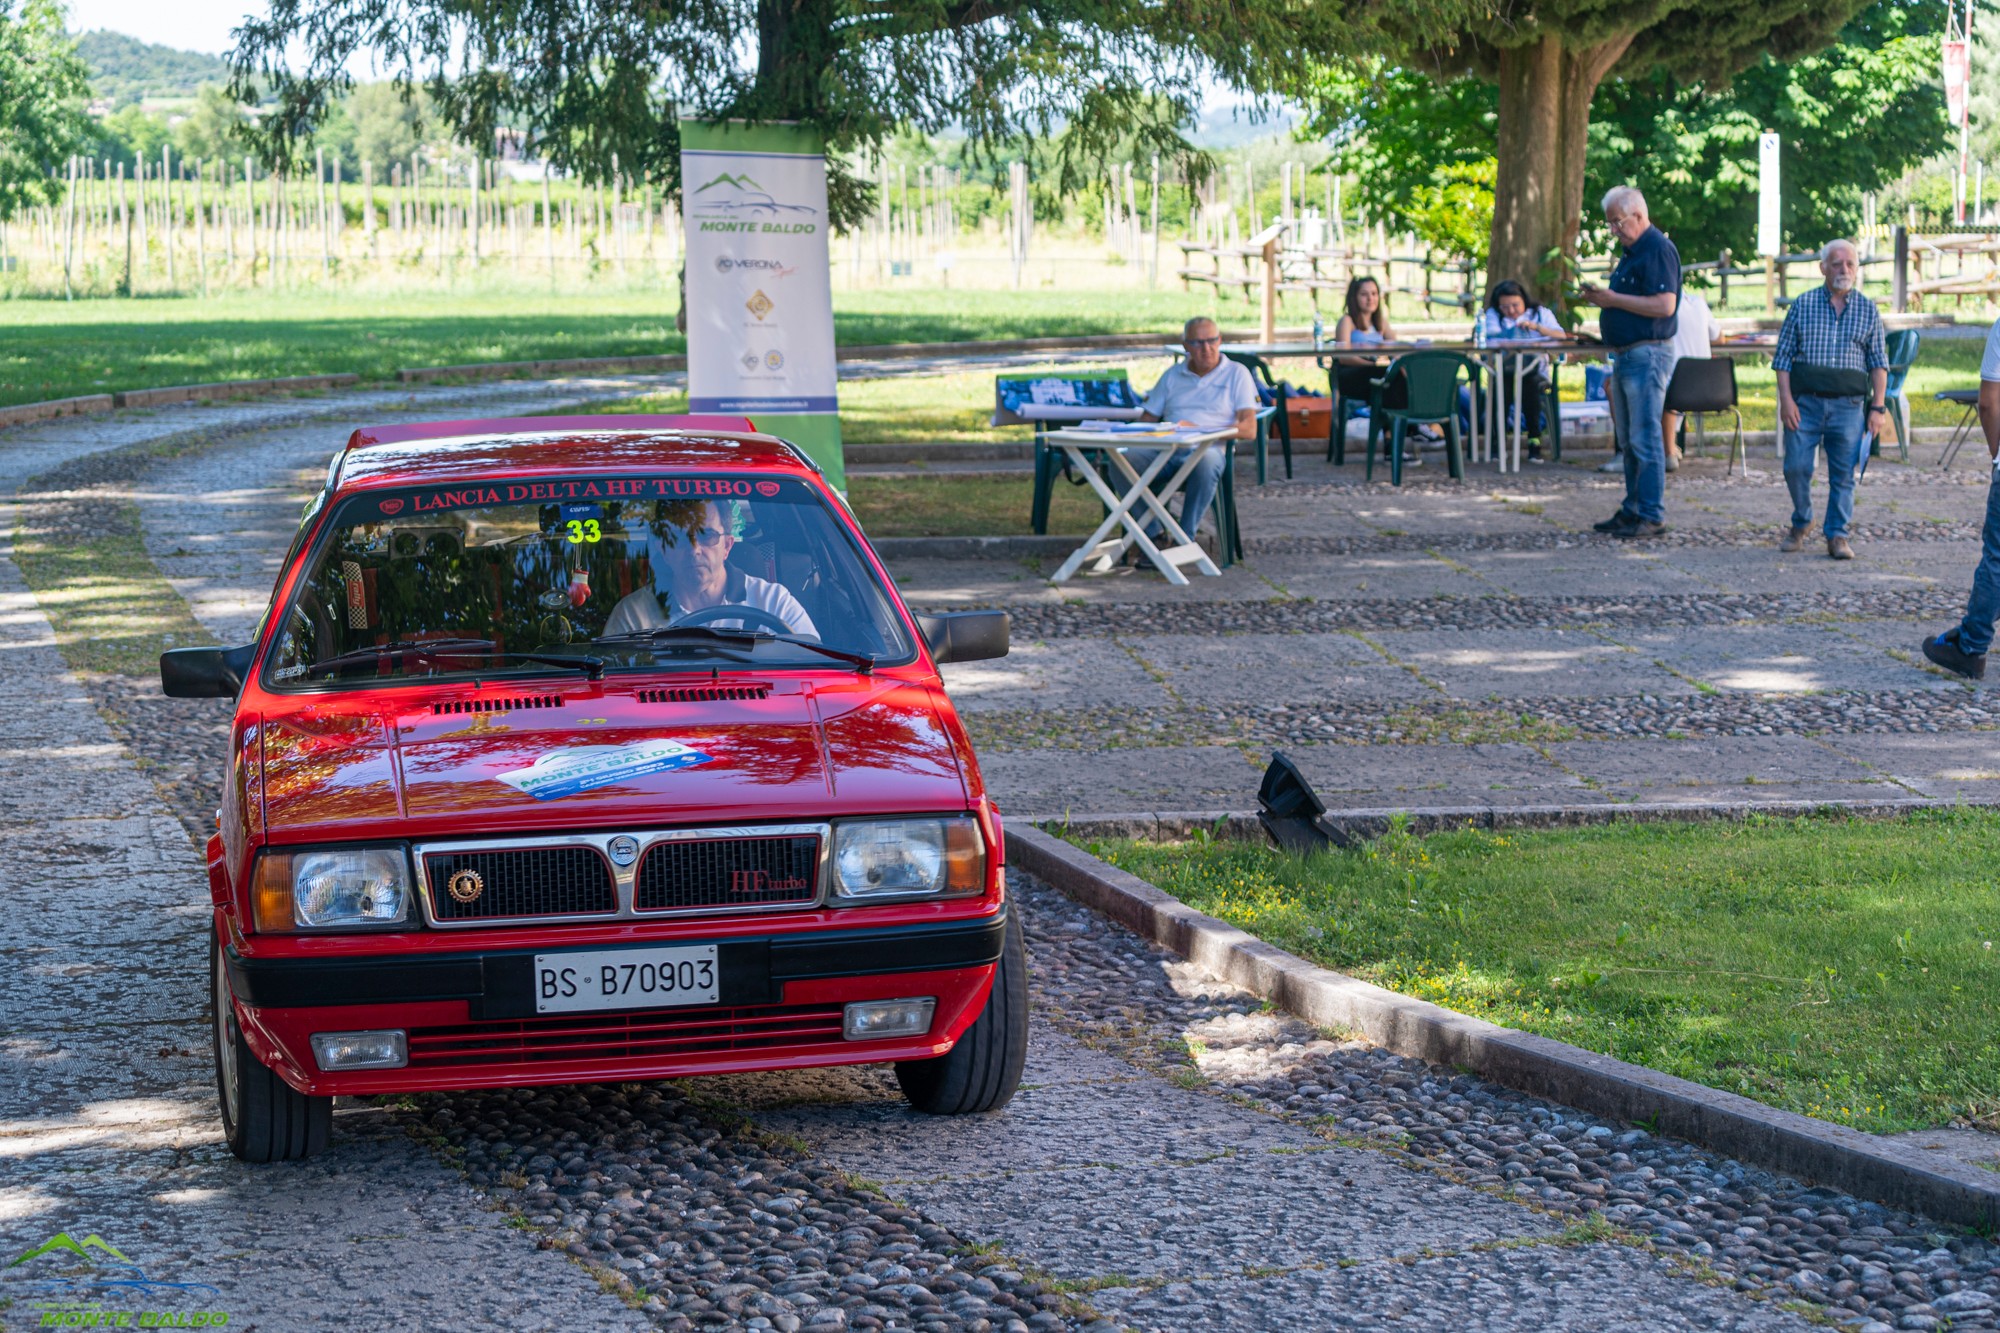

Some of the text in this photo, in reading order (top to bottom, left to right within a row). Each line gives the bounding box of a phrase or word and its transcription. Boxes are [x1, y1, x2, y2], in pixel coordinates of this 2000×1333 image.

[700, 221, 816, 235] MONTE BALDO
[735, 259, 784, 269] VERONA
[413, 488, 502, 511] LANCIA
[506, 481, 602, 501] DELTA
[605, 479, 646, 496] HF
[652, 479, 752, 496] TURBO
[566, 518, 602, 544] 33
[520, 765, 601, 788] MONTE
[606, 747, 683, 767] BALDO
[730, 870, 808, 893] HF turbo
[541, 959, 714, 999] BS B70903
